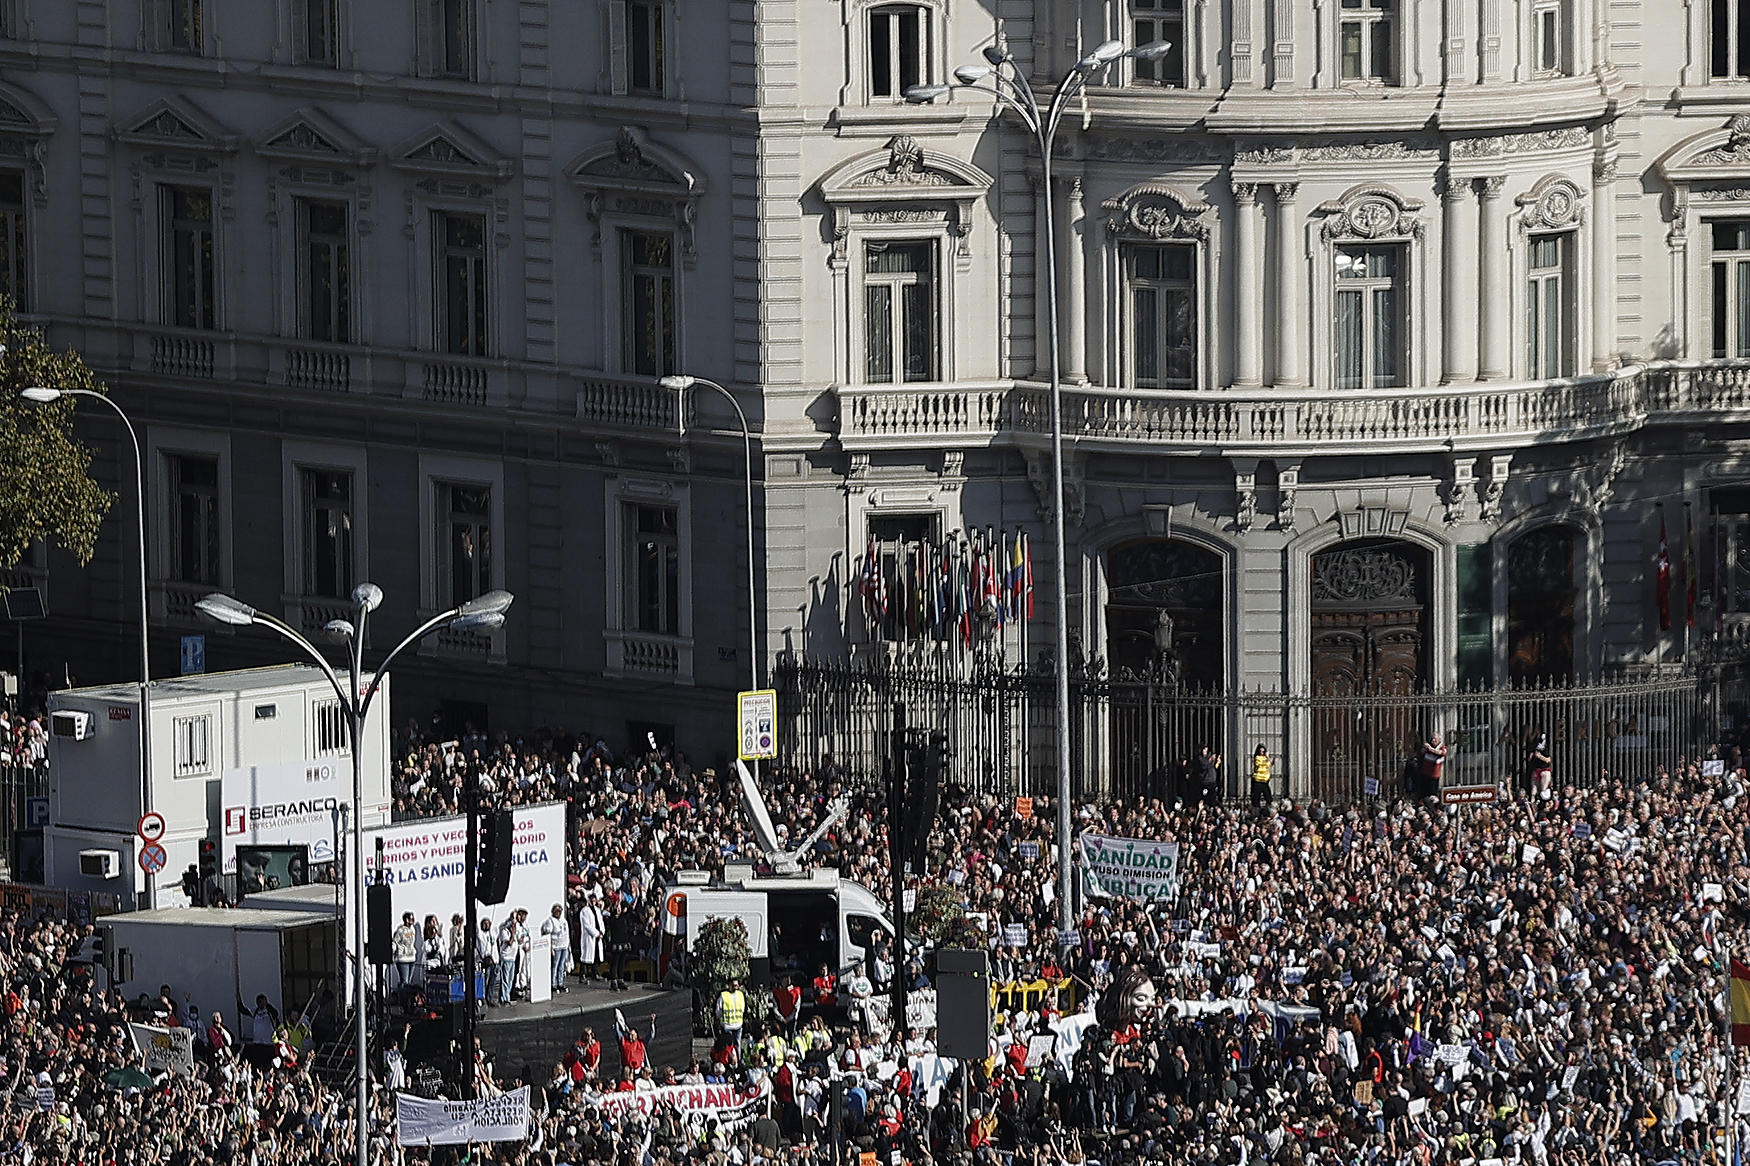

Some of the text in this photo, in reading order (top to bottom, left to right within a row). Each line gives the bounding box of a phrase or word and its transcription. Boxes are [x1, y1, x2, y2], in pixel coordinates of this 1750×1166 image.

[32, 800, 49, 824] P
[250, 797, 337, 820] SERANCO
[250, 813, 324, 831] EMPRESA CONSTRUCTORA
[366, 851, 418, 866] BRRIOS
[421, 849, 428, 859] Y
[511, 832, 546, 845] ADRID
[432, 833, 439, 843] Y
[365, 870, 395, 887] PR
[399, 868, 417, 883] LA
[511, 849, 549, 866] BLICA
[1086, 845, 1172, 869] SANIDAD
[1091, 864, 1120, 876] YUSO
